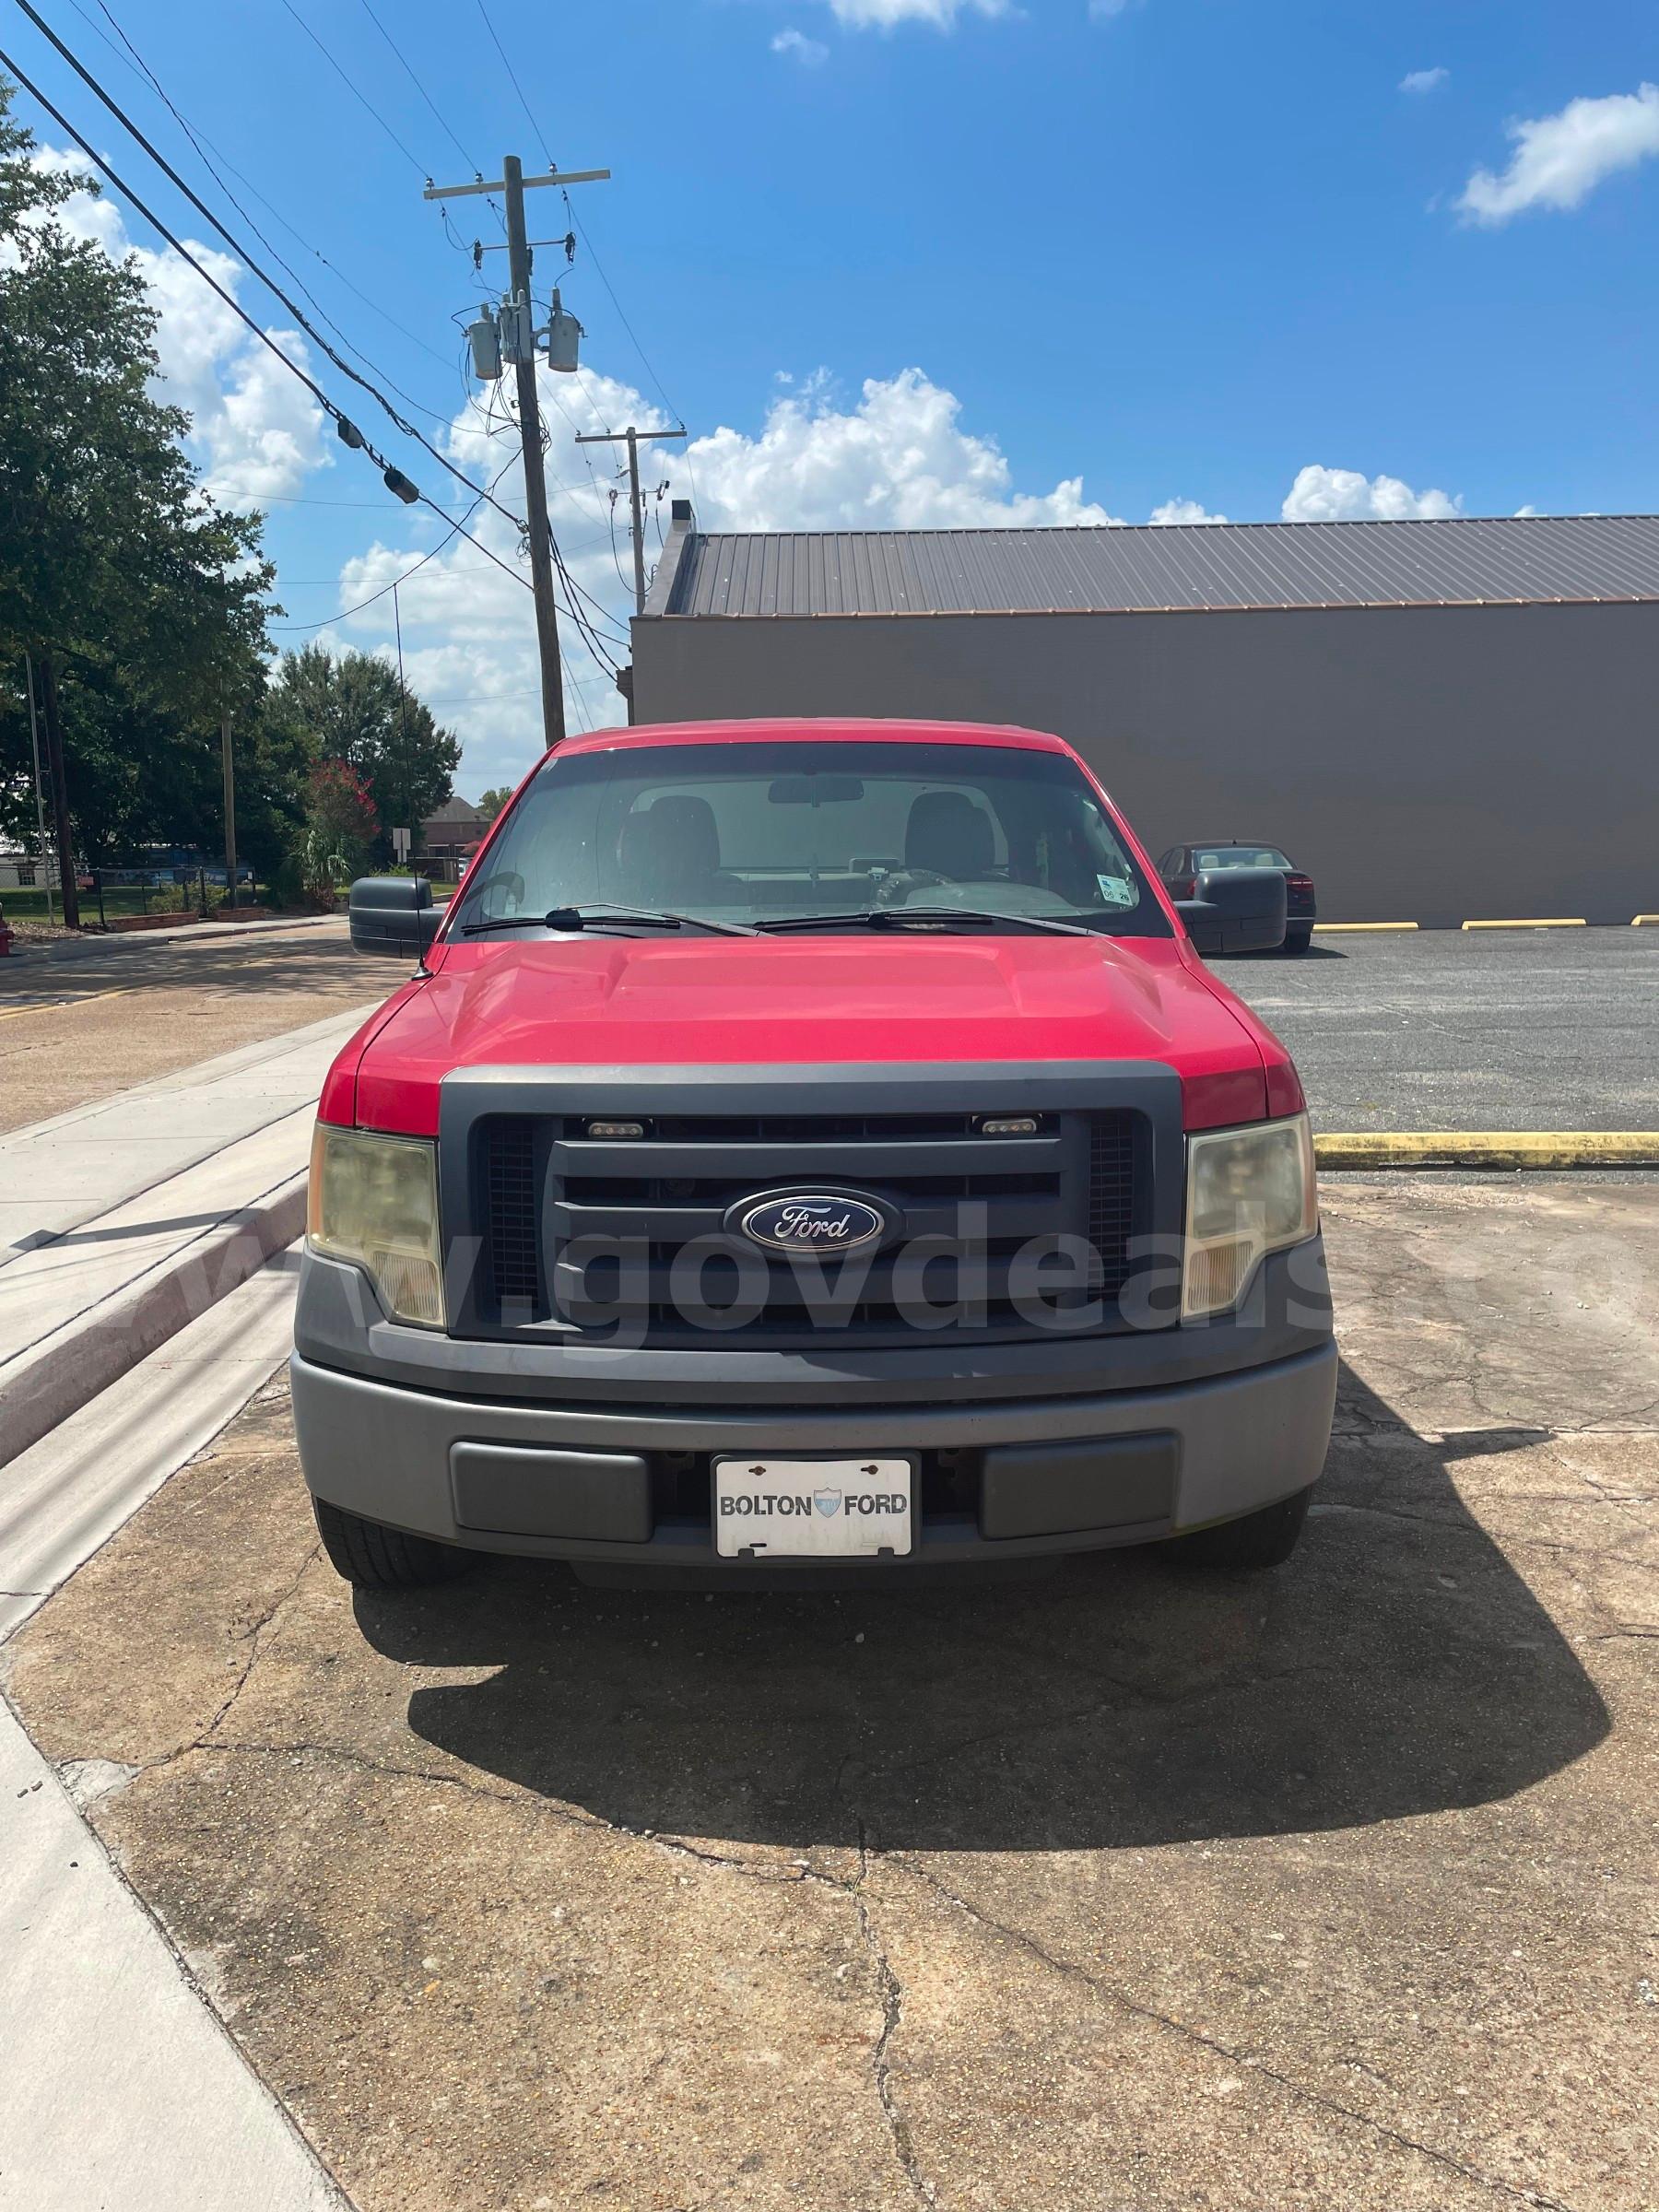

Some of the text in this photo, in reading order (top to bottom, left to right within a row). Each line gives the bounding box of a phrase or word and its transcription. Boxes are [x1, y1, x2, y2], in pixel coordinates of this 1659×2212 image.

[774, 1206, 851, 1238] Ford
[720, 1495, 812, 1516] BOLTON
[844, 1494, 907, 1515] FORD
